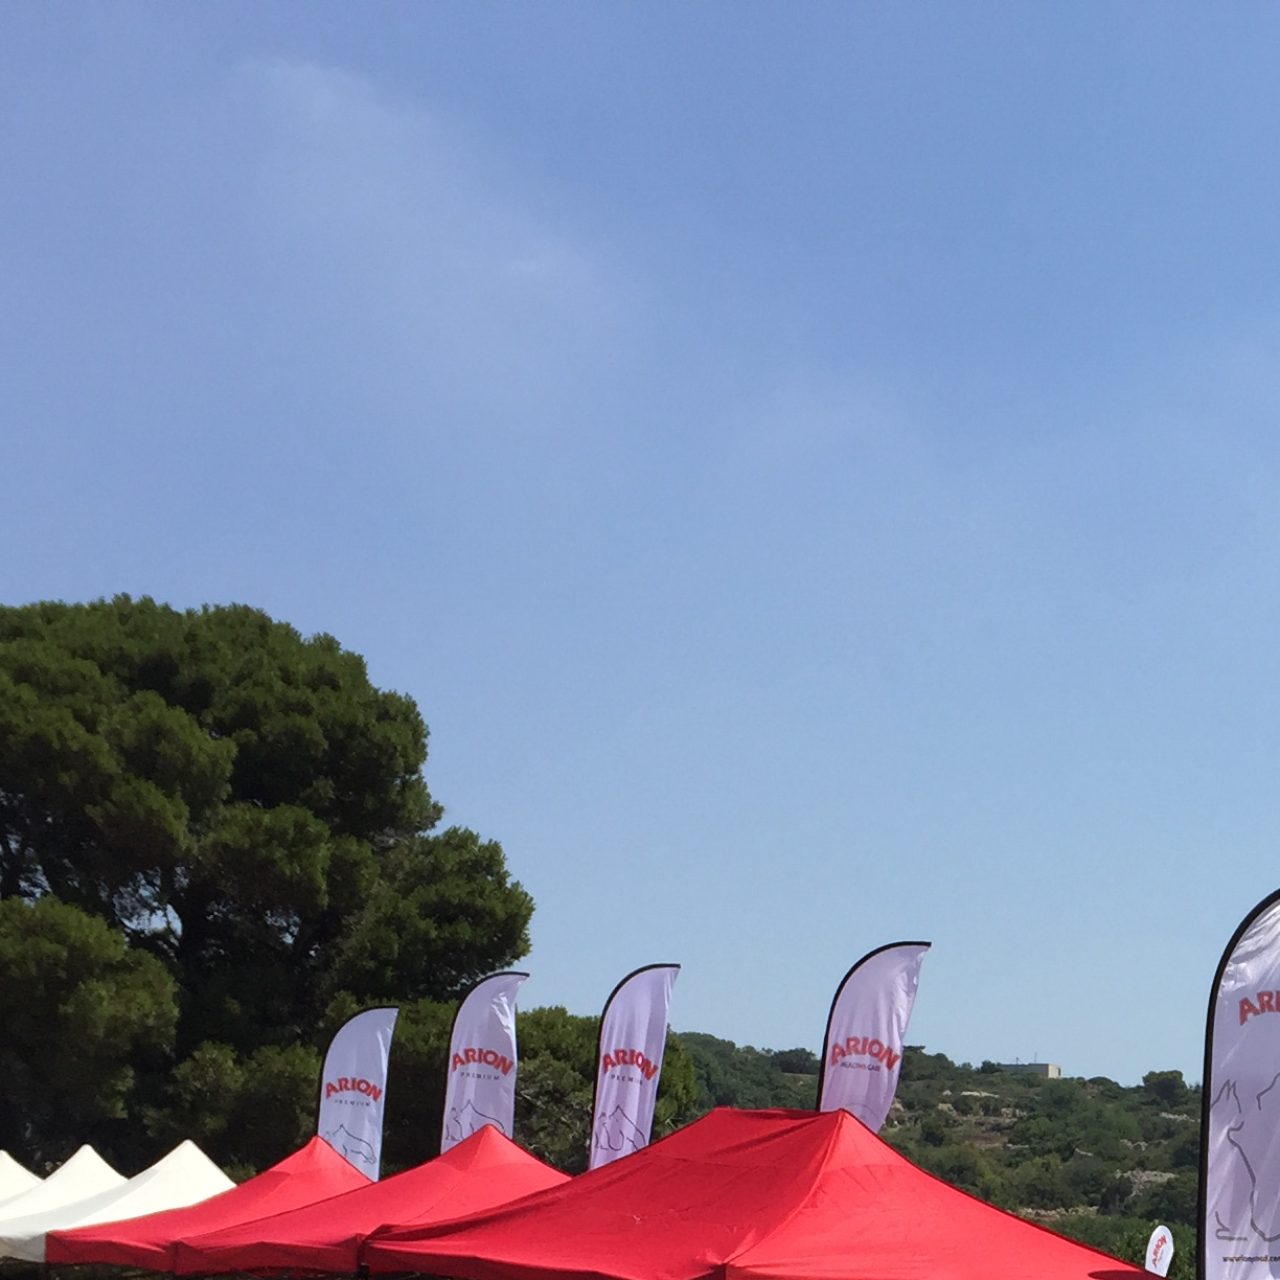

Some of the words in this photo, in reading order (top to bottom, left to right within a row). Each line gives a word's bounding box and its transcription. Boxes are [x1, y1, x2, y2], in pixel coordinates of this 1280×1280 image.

[452, 1048, 514, 1076] ARION
[603, 1049, 658, 1080] ARION
[831, 1036, 900, 1071] ARION
[326, 1077, 382, 1102] ARION
